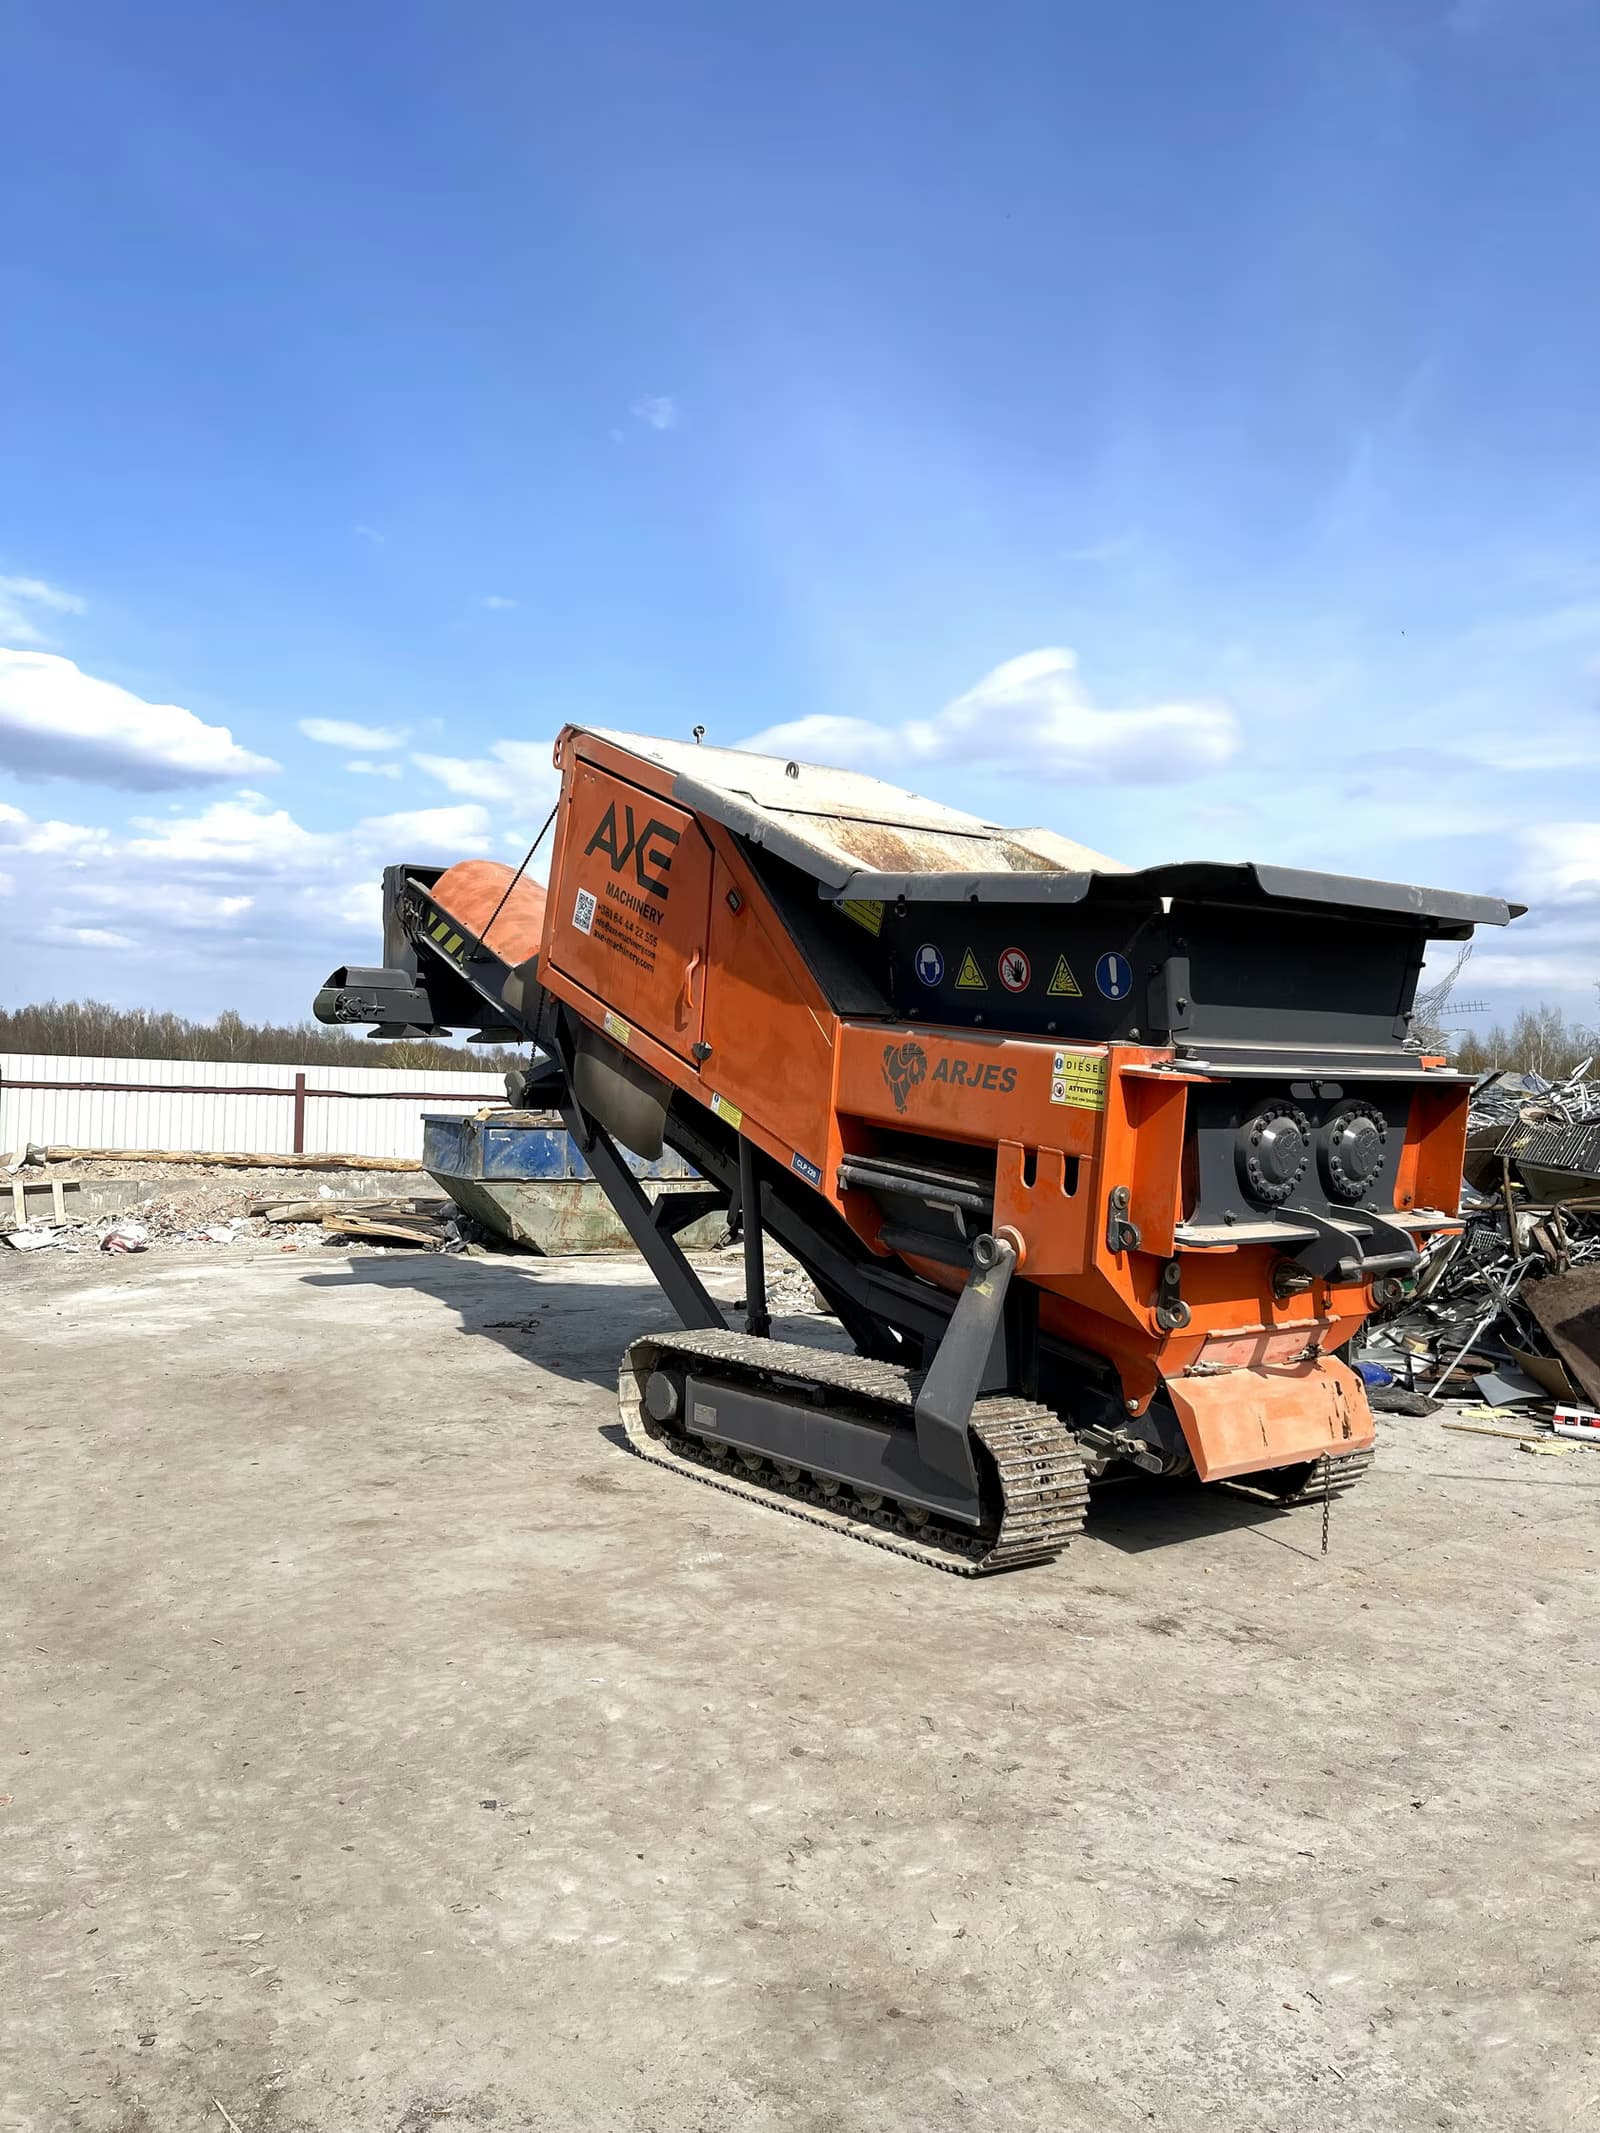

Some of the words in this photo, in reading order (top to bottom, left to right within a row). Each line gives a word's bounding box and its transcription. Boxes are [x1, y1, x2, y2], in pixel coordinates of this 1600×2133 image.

[584, 801, 681, 900] AXE
[605, 881, 664, 925] MACHINERY
[625, 920, 634, 932] 44
[635, 926, 644, 939] 22
[644, 932, 658, 948] 555
[931, 1058, 1018, 1093] ARJES
[1066, 1061, 1104, 1074] DIESEL
[1069, 1085, 1103, 1095] ATTENTION
